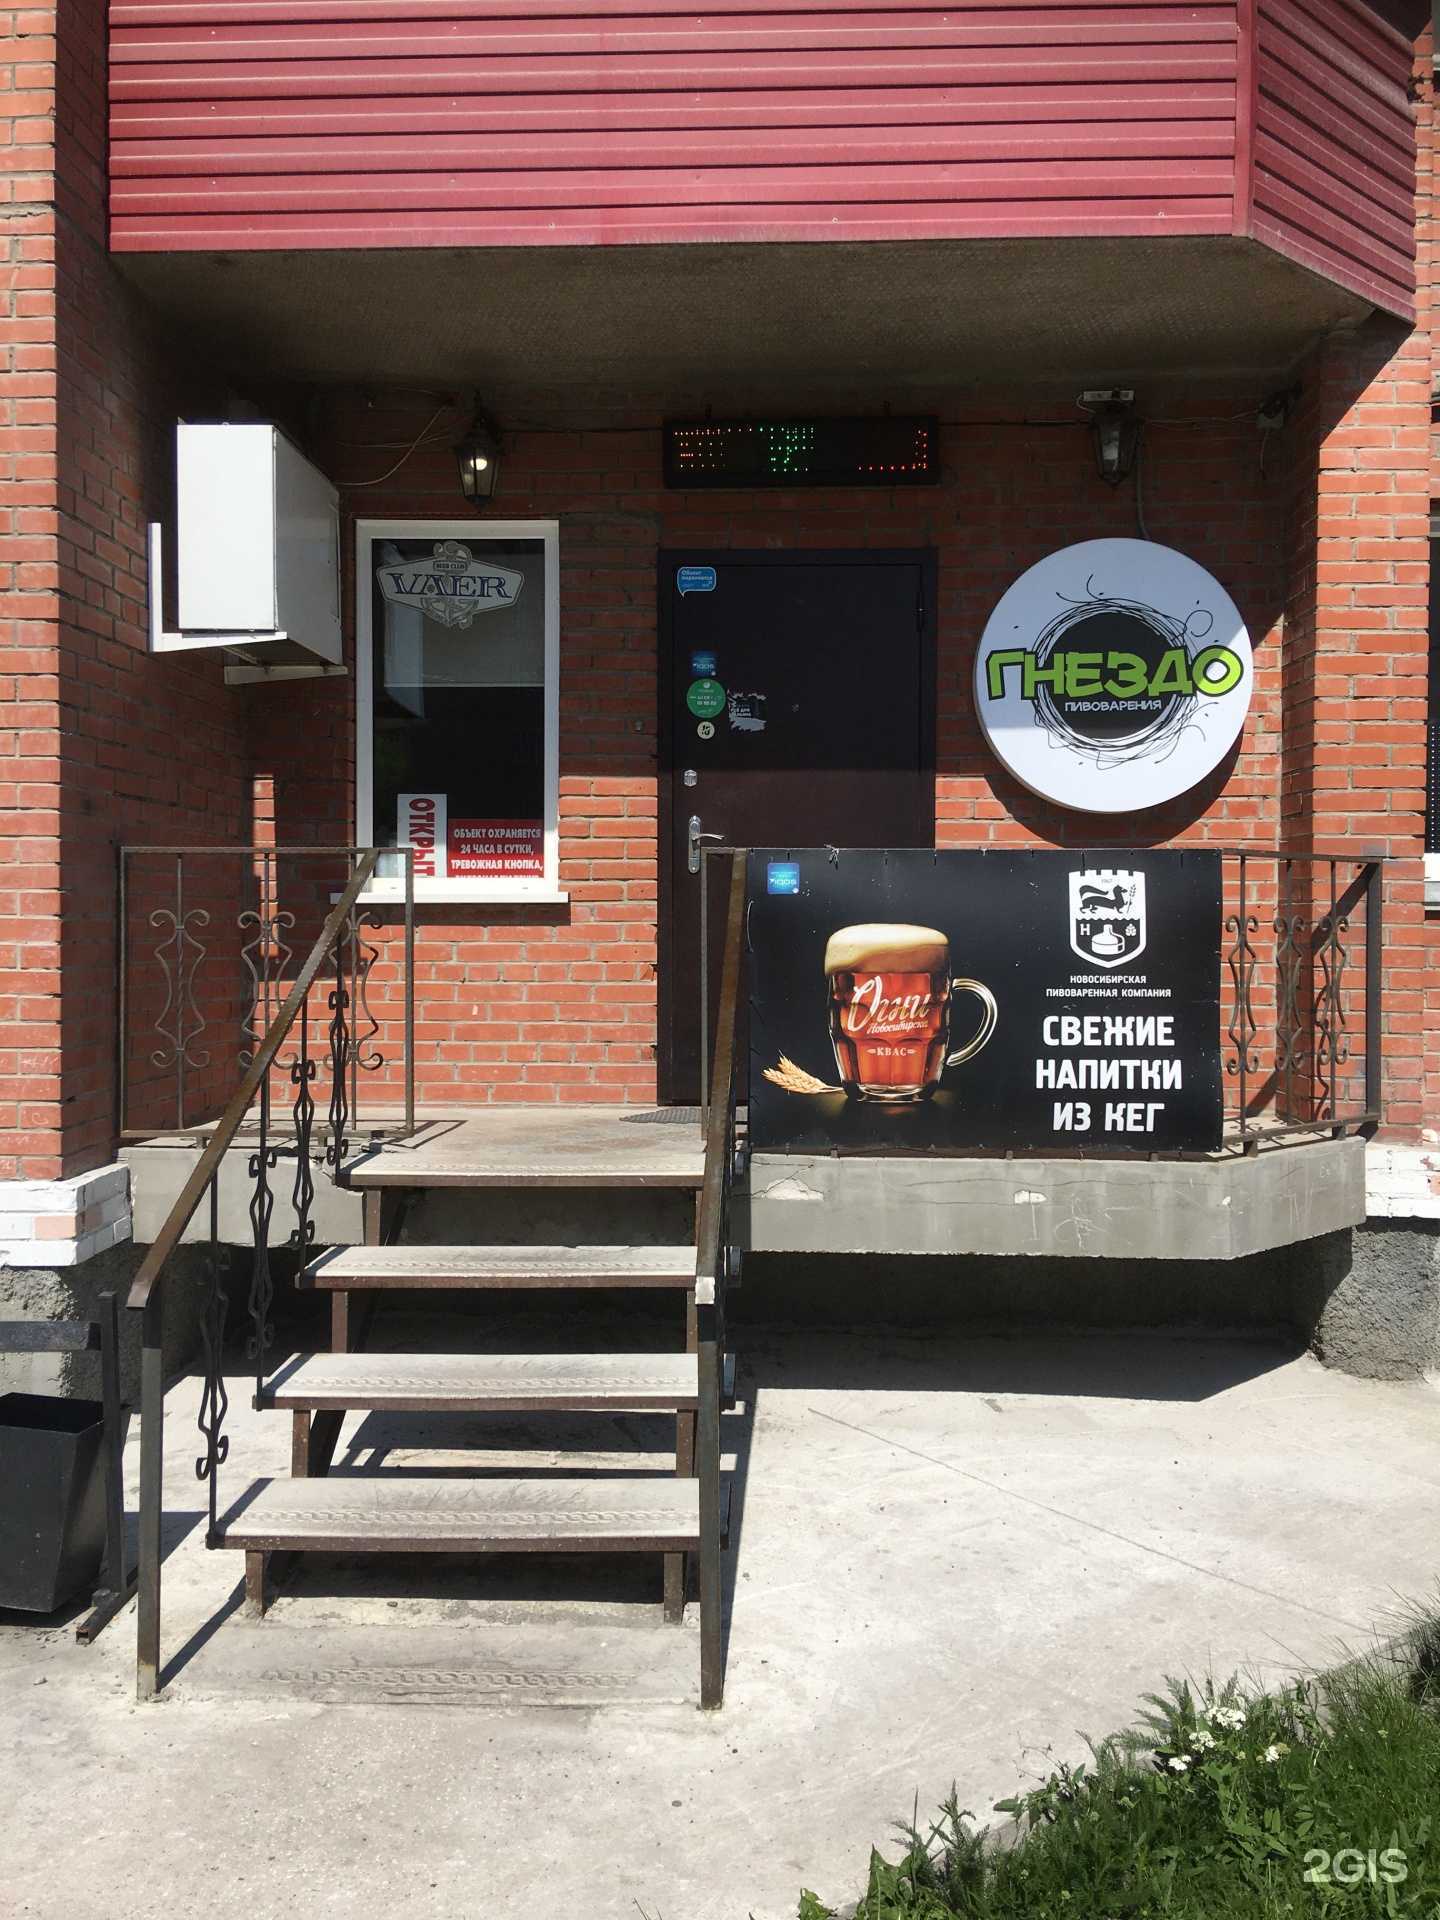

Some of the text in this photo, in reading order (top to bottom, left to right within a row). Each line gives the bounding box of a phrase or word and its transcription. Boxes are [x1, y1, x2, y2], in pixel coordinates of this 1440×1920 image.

[986, 645, 1244, 700] ГНЕЗДО
[1064, 700, 1163, 713] ПИВОВАРЕНИЯ
[453, 828, 487, 839] ОБЪЕКТ
[460, 844, 534, 856] 24 ЧАСА В СУТКИ,
[451, 859, 543, 872] ТРЕВОЖНАЯ КНОПКА,
[1070, 975, 1147, 984] НОВОСИБИРСКАЯ
[1046, 988, 1172, 998] ПИВОВАРЕННАЯ КОМПАНИЯ
[848, 976, 931, 1031] Огни
[1042, 1015, 1176, 1047] СВЕЖИЕ
[876, 1047, 907, 1057] КВАС
[1035, 1058, 1183, 1090] НАПИТКИ
[1052, 1102, 1166, 1132] ИЗ КЕГ
